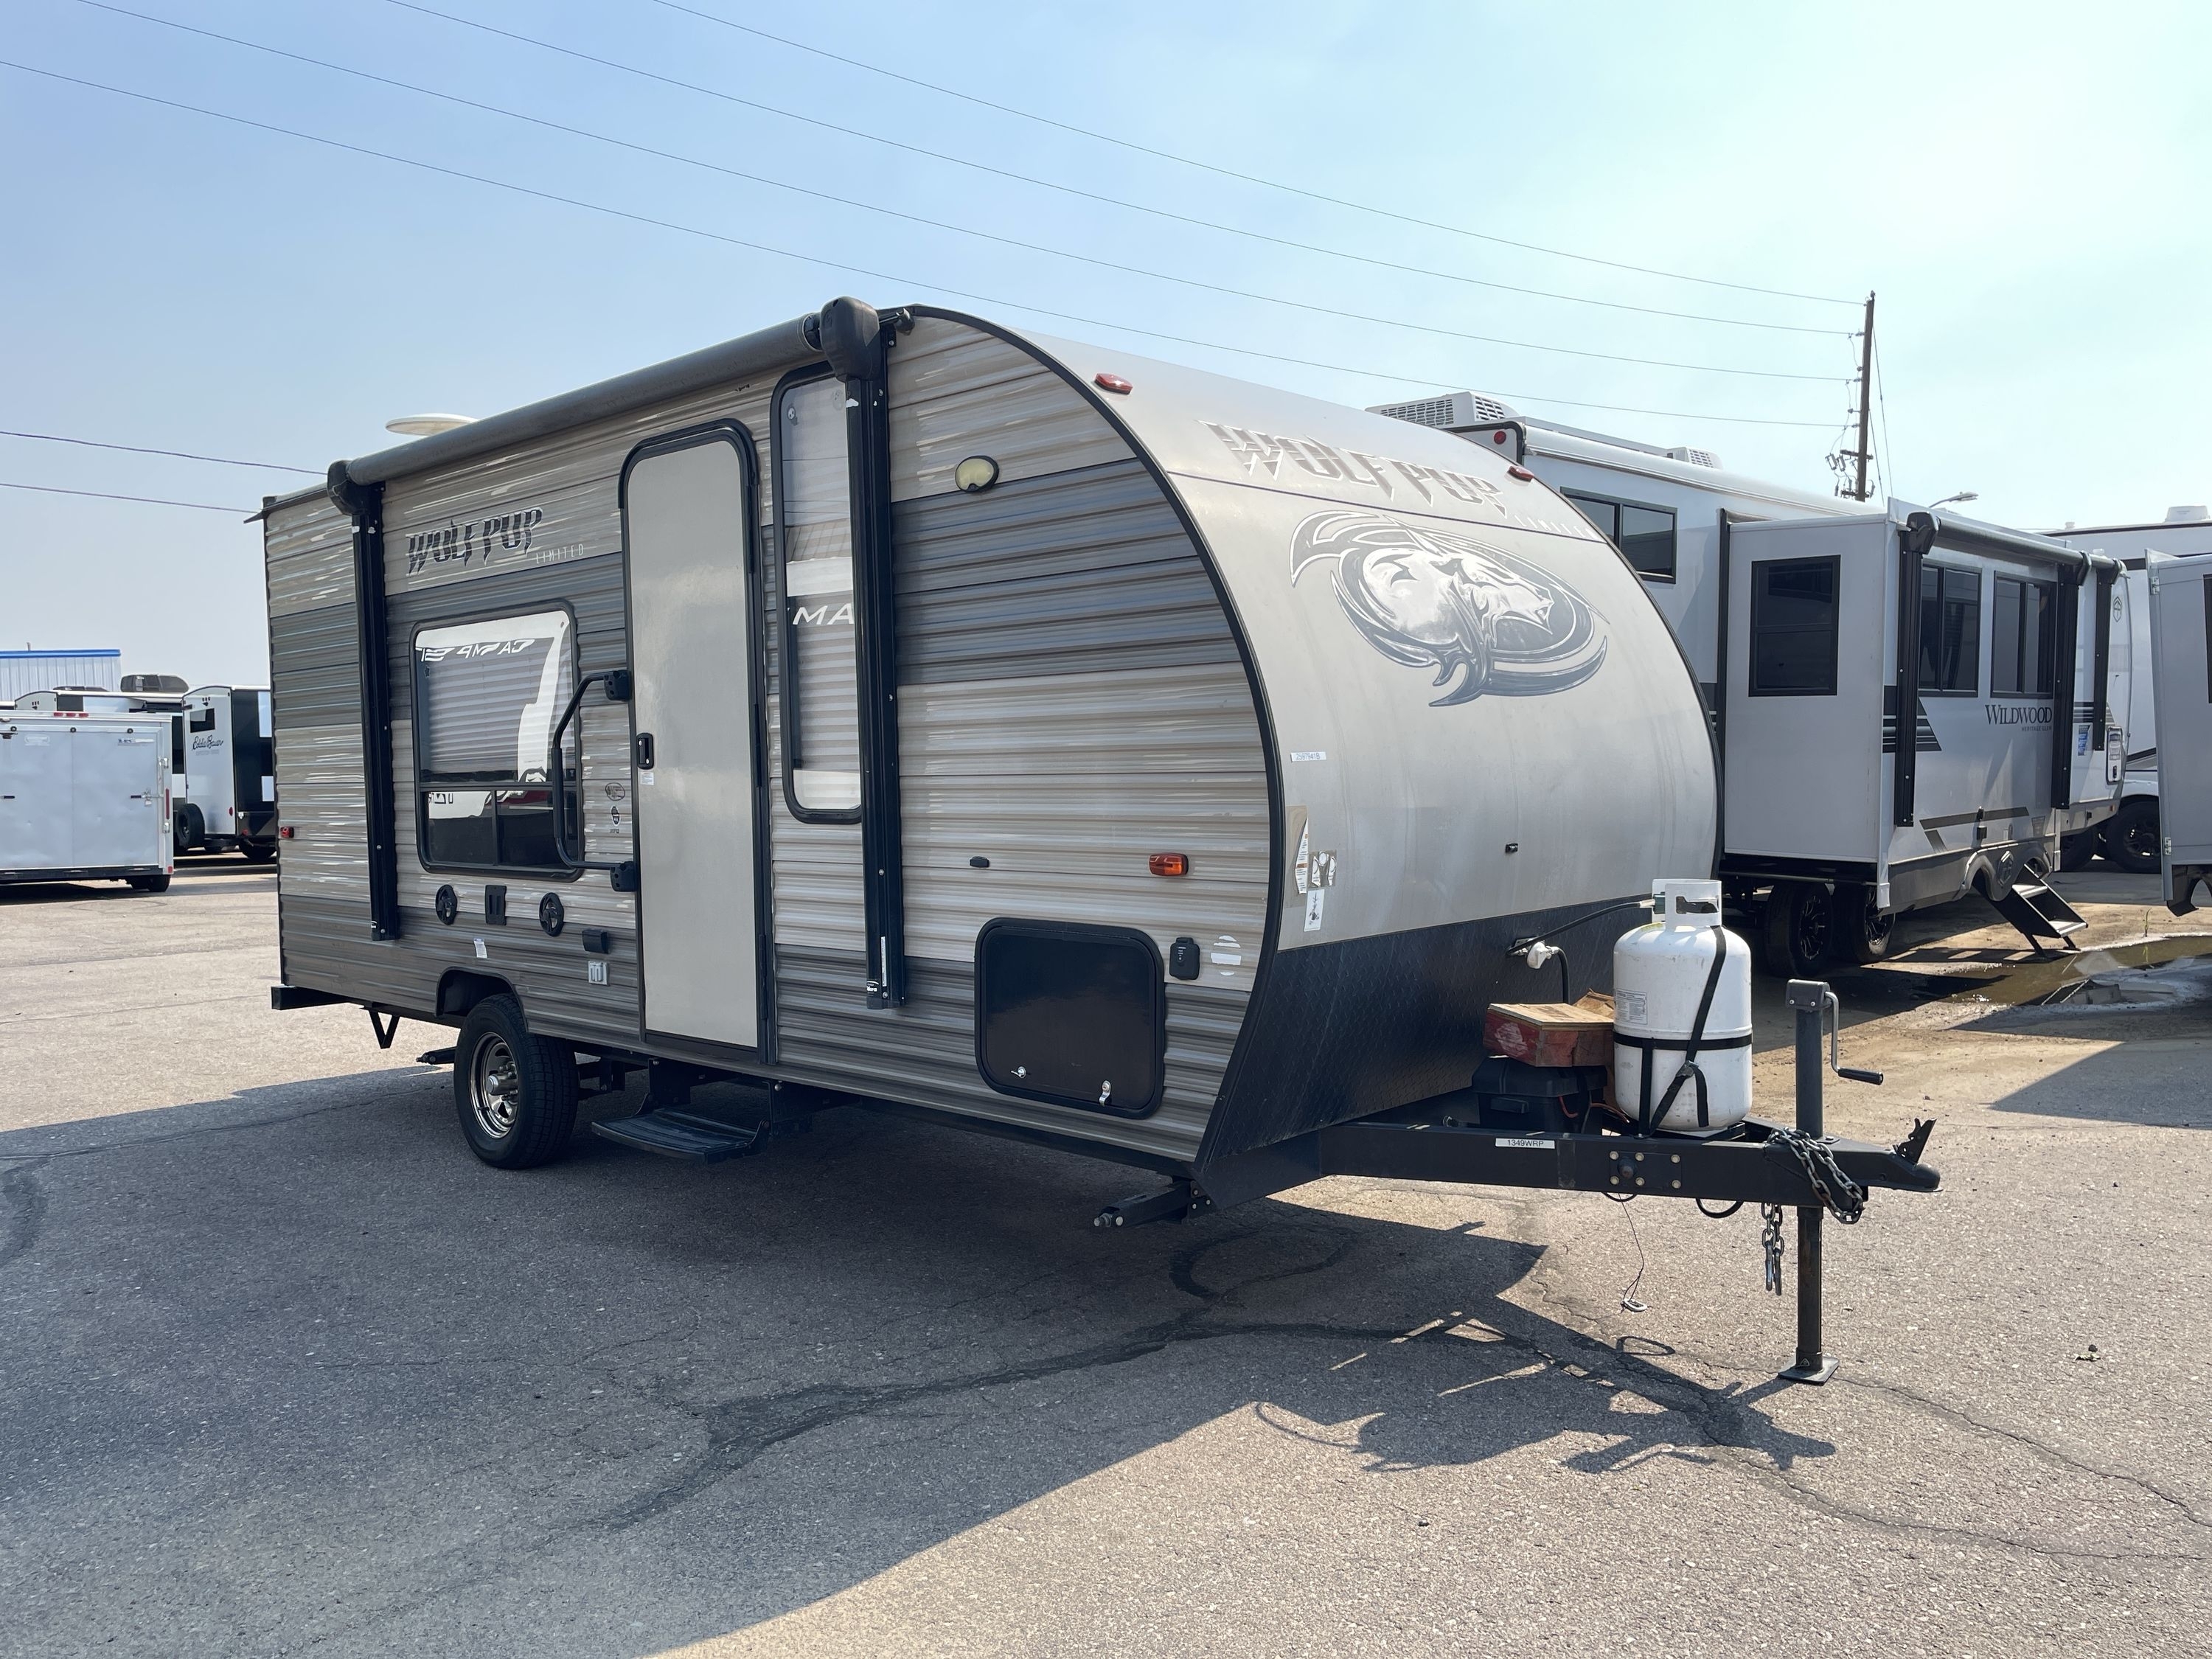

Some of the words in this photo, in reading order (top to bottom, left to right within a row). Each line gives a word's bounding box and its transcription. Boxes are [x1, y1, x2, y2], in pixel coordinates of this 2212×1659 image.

[1194, 420, 1394, 503] WOLF
[1382, 456, 1508, 519] PUP
[406, 518, 479, 577] WOLF
[481, 507, 543, 566] PUP
[536, 543, 585, 564] LIMITED
[1984, 704, 2053, 726] WILDWOOD
[1506, 1139, 1544, 1147] 1349WRP
